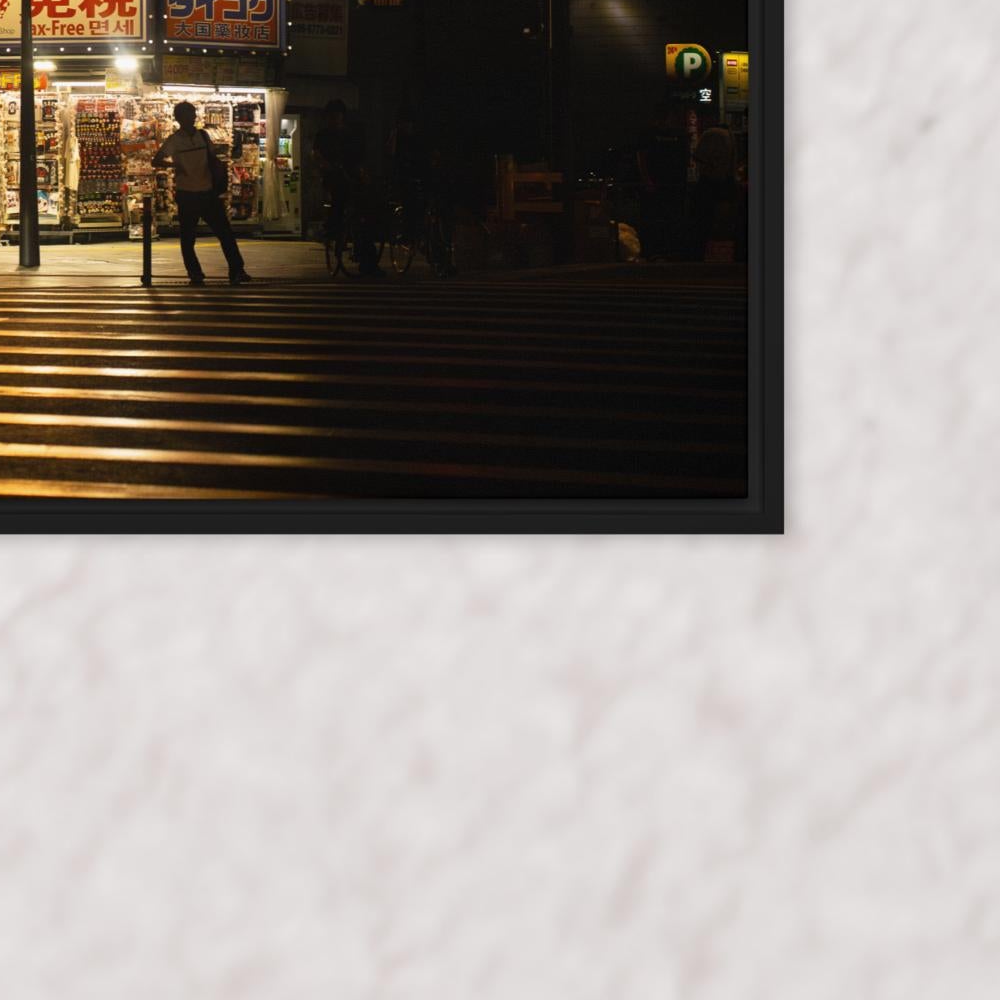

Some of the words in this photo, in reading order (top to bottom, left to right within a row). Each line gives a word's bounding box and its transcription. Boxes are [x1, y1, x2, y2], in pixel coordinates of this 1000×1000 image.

[21, 19, 85, 36] ax-Free
[89, 19, 134, 36] 면세
[683, 52, 703, 79] P
[699, 88, 712, 102] 空
